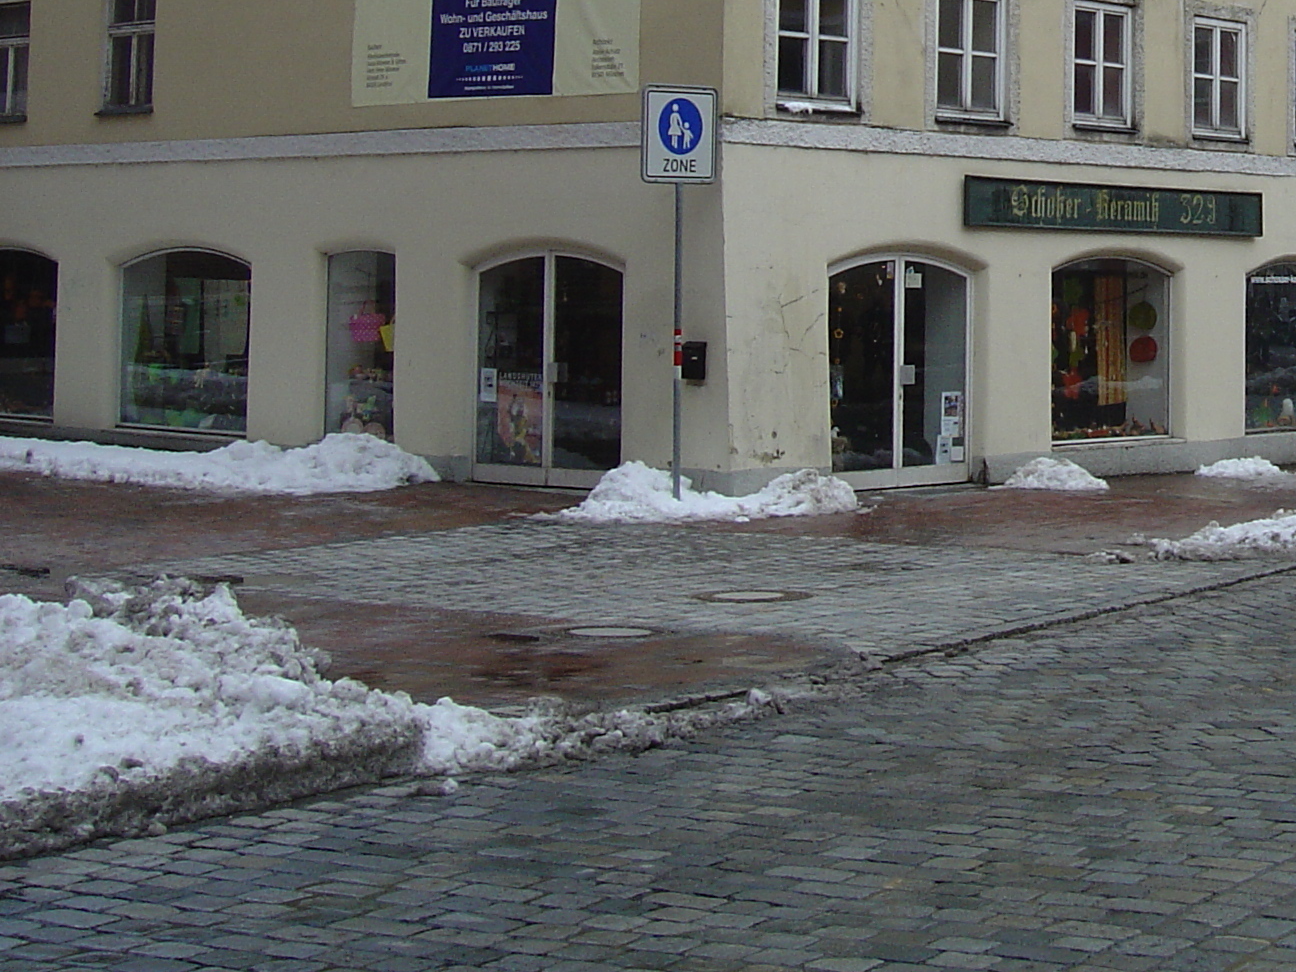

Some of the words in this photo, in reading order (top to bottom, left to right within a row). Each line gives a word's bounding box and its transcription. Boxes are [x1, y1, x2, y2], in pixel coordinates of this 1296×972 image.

[440, 13, 466, 24] Wohn-
[467, 12, 484, 23] und
[485, 9, 548, 23] Geschäftshaus
[459, 27, 472, 39] ZU
[473, 25, 525, 38] VERKAUFEN
[463, 42, 482, 53] 0871
[488, 41, 503, 52] 293
[504, 40, 521, 51] 225
[663, 158, 697, 173] ZONE
[1097, 189, 1160, 228] Keramik
[1180, 193, 1216, 225] 329
